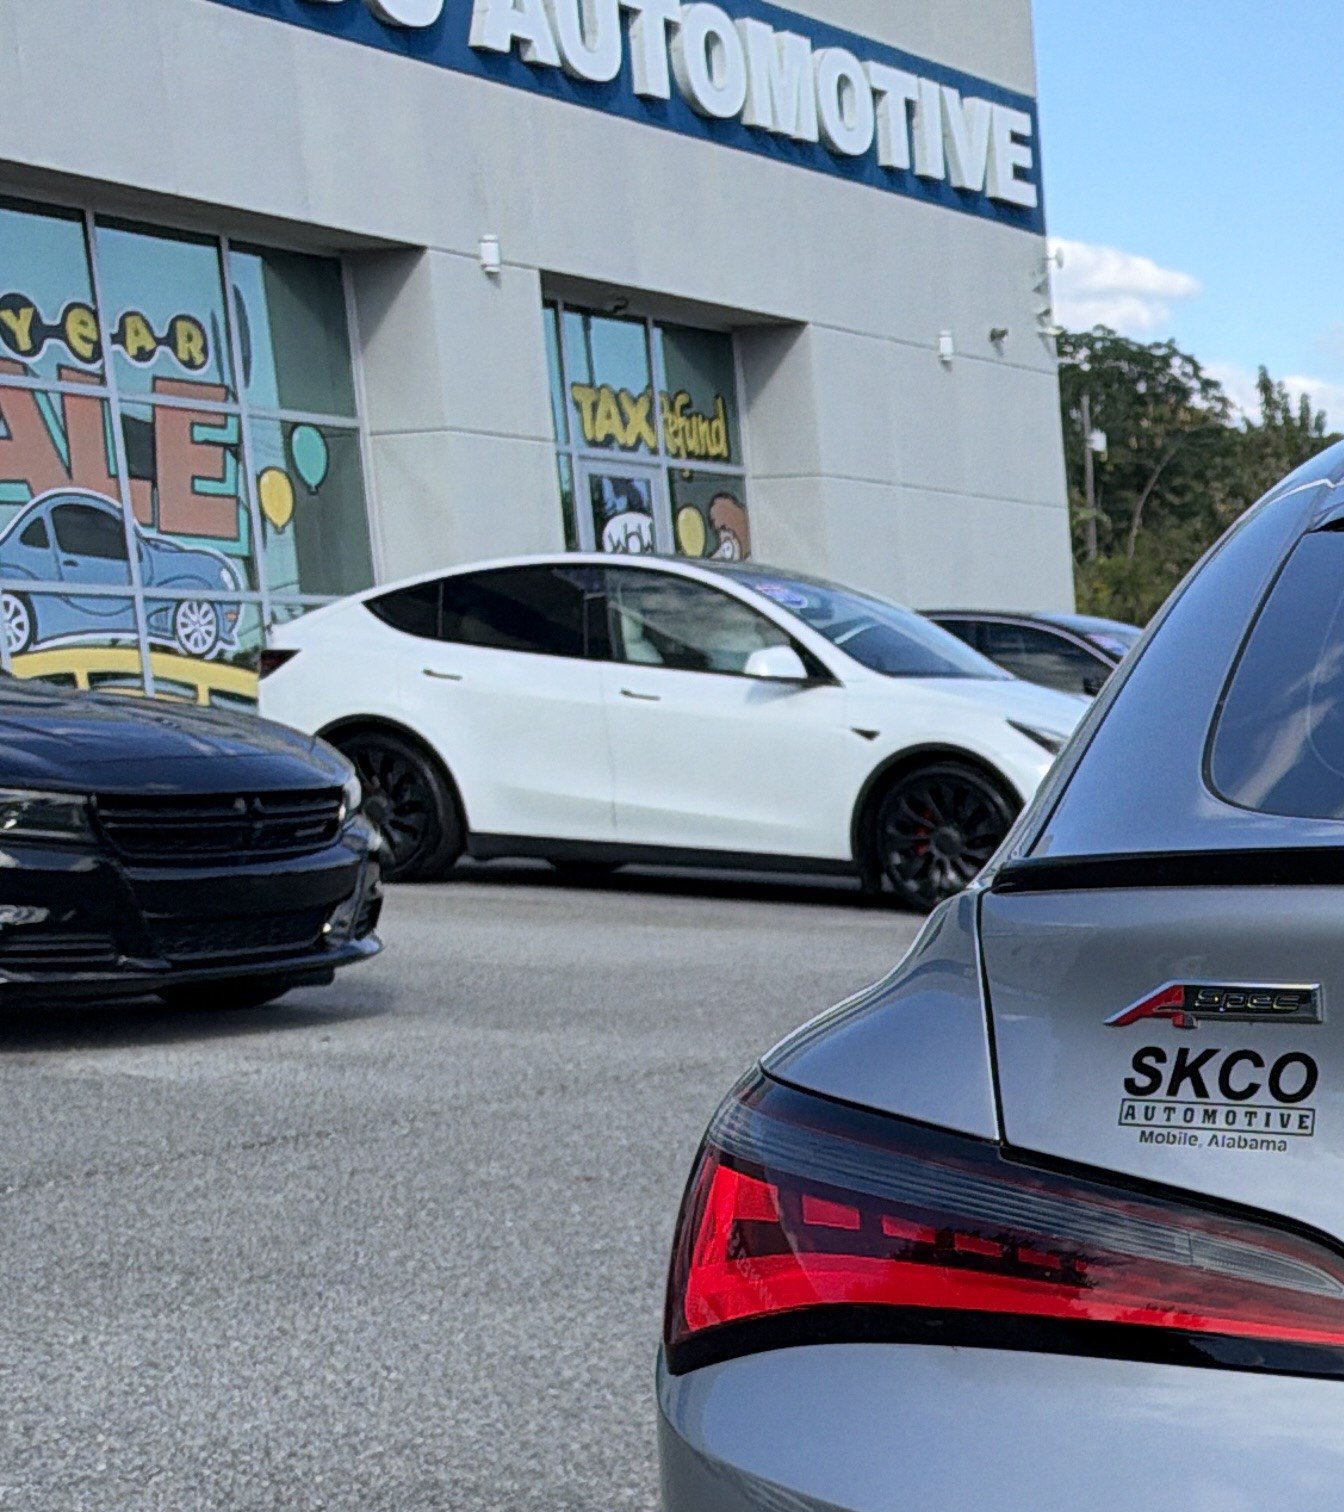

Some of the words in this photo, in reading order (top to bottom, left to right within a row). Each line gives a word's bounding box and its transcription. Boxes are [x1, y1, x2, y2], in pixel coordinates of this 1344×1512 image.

[467, 0, 1038, 208] AUTOMOTIVE
[571, 383, 658, 449] TAX
[1122, 1046, 1319, 1104] SKCO
[1123, 1104, 1310, 1130] AUTOMOTIVE
[1139, 1130, 1202, 1149] Mobile,
[1207, 1134, 1288, 1152] Alabama
